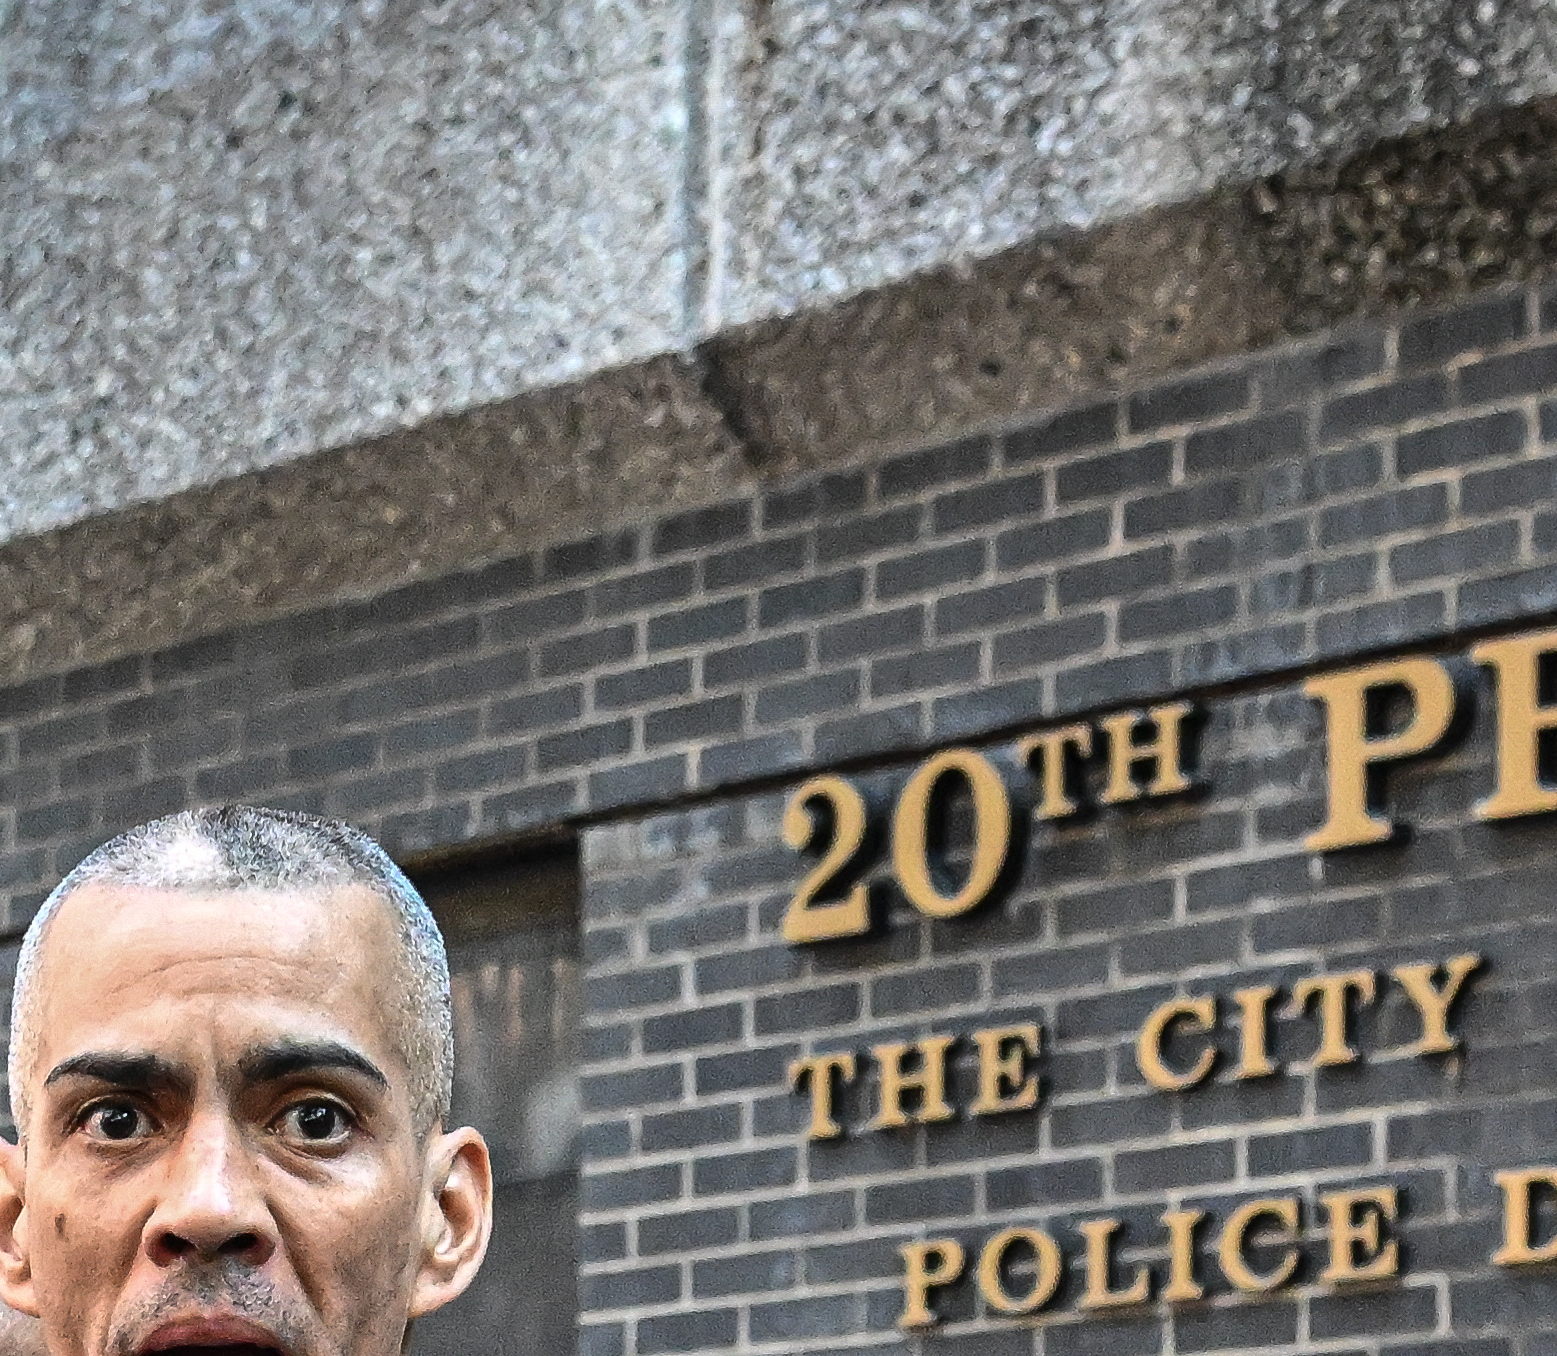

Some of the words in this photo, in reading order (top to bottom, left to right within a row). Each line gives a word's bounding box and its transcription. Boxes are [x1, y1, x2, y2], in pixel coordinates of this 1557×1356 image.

[782, 703, 1188, 943] 20TH
[789, 1023, 1040, 1138] THE
[1137, 954, 1478, 1090] CITY
[900, 1187, 1398, 1328] POLICE
